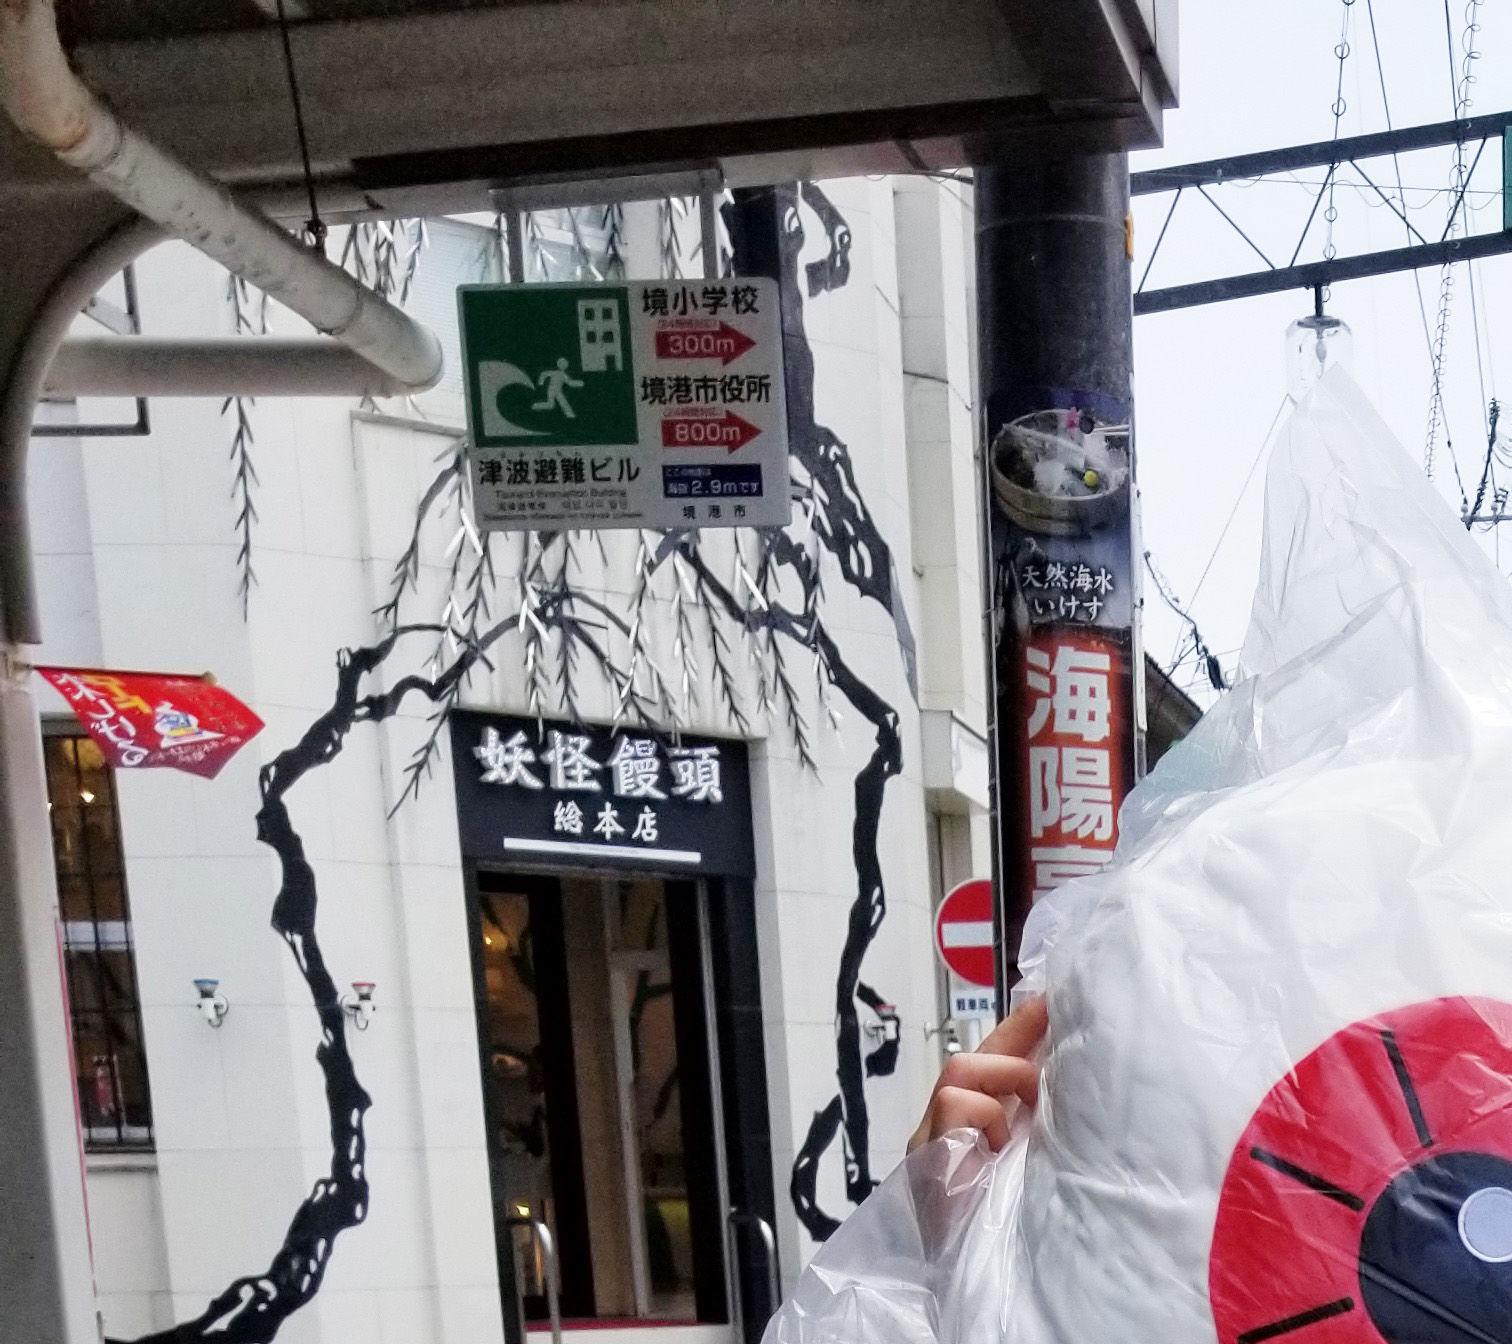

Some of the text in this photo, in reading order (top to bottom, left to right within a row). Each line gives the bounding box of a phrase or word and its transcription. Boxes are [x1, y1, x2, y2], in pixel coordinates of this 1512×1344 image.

[642, 286, 760, 316] 境小学校
[669, 334, 735, 354] 300m
[641, 374, 772, 405] 境港市役所
[674, 422, 741, 442] 800m
[478, 456, 640, 487] 津波避難ビル
[1022, 563, 1114, 595] 天然海水
[1034, 595, 1104, 622] いけす
[473, 726, 724, 803] 妖怪饅頭
[553, 800, 659, 842] 総本店
